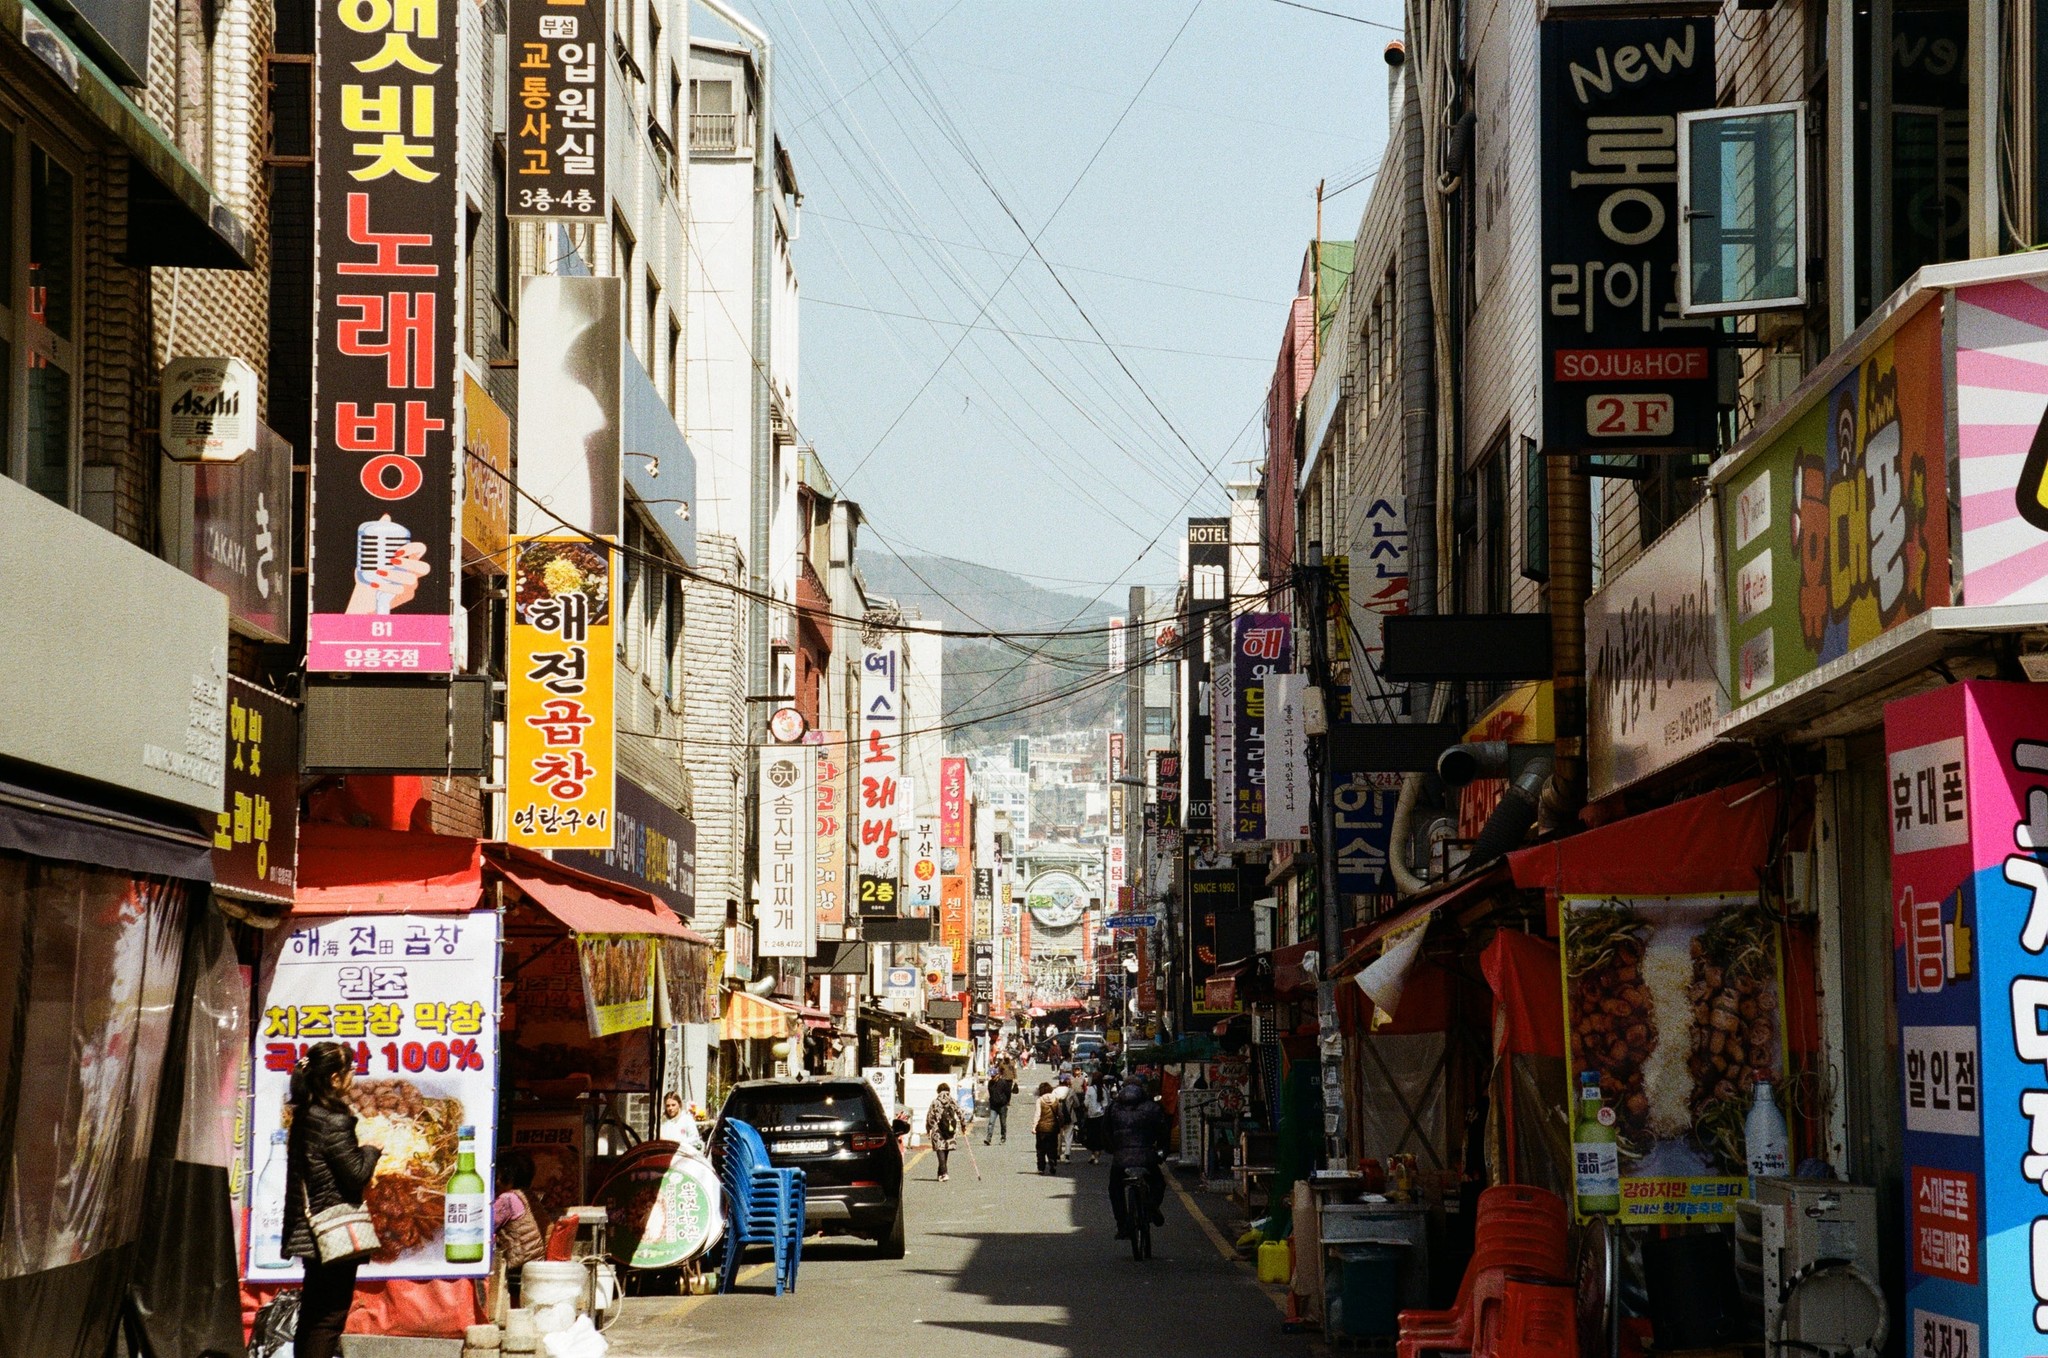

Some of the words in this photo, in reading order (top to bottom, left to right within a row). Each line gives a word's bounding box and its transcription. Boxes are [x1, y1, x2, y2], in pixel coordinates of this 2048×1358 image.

[543, 18, 575, 35] 부설
[1569, 24, 1696, 104] New
[337, 0, 443, 184] 햇빛
[519, 43, 551, 176] 교통사고
[555, 43, 595, 176] 입원실
[335, 192, 445, 500] 노래방
[1563, 352, 1700, 378] SOJU&HOF
[170, 389, 240, 417] Asahi
[1596, 398, 1668, 434] 2F
[196, 421, 214, 435] 生
[1189, 529, 1228, 542] HOTEL
[371, 621, 392, 637] B1
[344, 649, 419, 668] 유흥주점
[526, 594, 596, 799] 해전곱창
[864, 649, 897, 721] 예스
[861, 729, 898, 859] 노래방
[1893, 760, 1965, 832] 휴대폰
[213, 791, 272, 880] 노래방
[514, 804, 606, 835] 연탄구이
[773, 794, 794, 931] 송지부대찌개
[916, 822, 936, 901] 부산횟집
[861, 880, 895, 902] 2층
[1193, 882, 1217, 894] SINCE
[1219, 882, 1236, 893] 1992
[1899, 885, 1944, 994] 1등
[338, 965, 408, 1000] 원조
[264, 1002, 403, 1038] 치즈곱창
[414, 1001, 486, 1037] 막창
[264, 1041, 371, 1075] 국산
[382, 1038, 484, 1073] 100%
[1907, 1049, 1976, 1112] 할인점
[1577, 1152, 1599, 1163] 좋은
[1577, 1163, 1600, 1175] 데이
[1623, 1181, 1687, 1198] 강하지만
[1690, 1183, 1743, 1197] 부드럽다
[1919, 1176, 1969, 1222] 스마트폰
[447, 1213, 468, 1224] 데이
[1920, 1226, 1970, 1276] 전문매장
